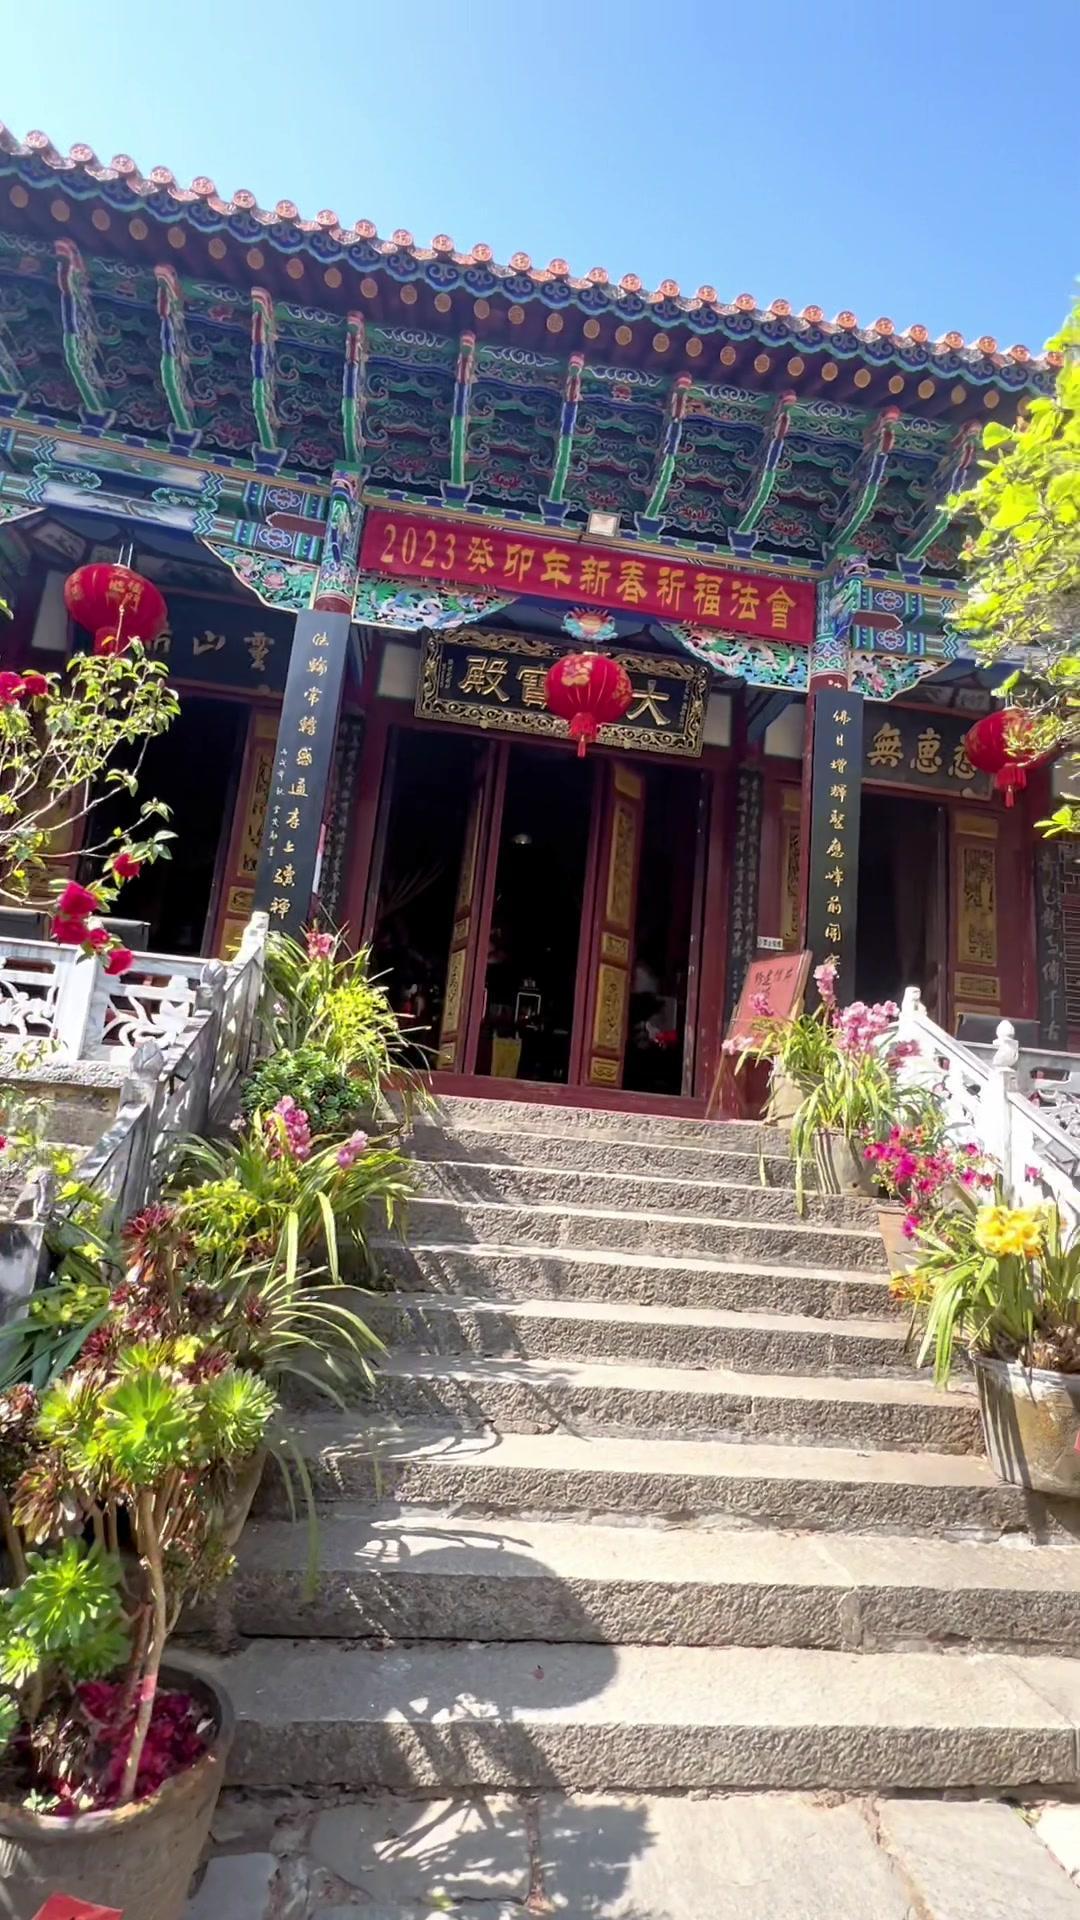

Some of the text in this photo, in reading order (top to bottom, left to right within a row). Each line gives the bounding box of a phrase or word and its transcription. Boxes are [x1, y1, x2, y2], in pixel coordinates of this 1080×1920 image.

[380, 523, 797, 630] 2023癸卯年新春祈福法會
[458, 655, 672, 727] 大寶殿
